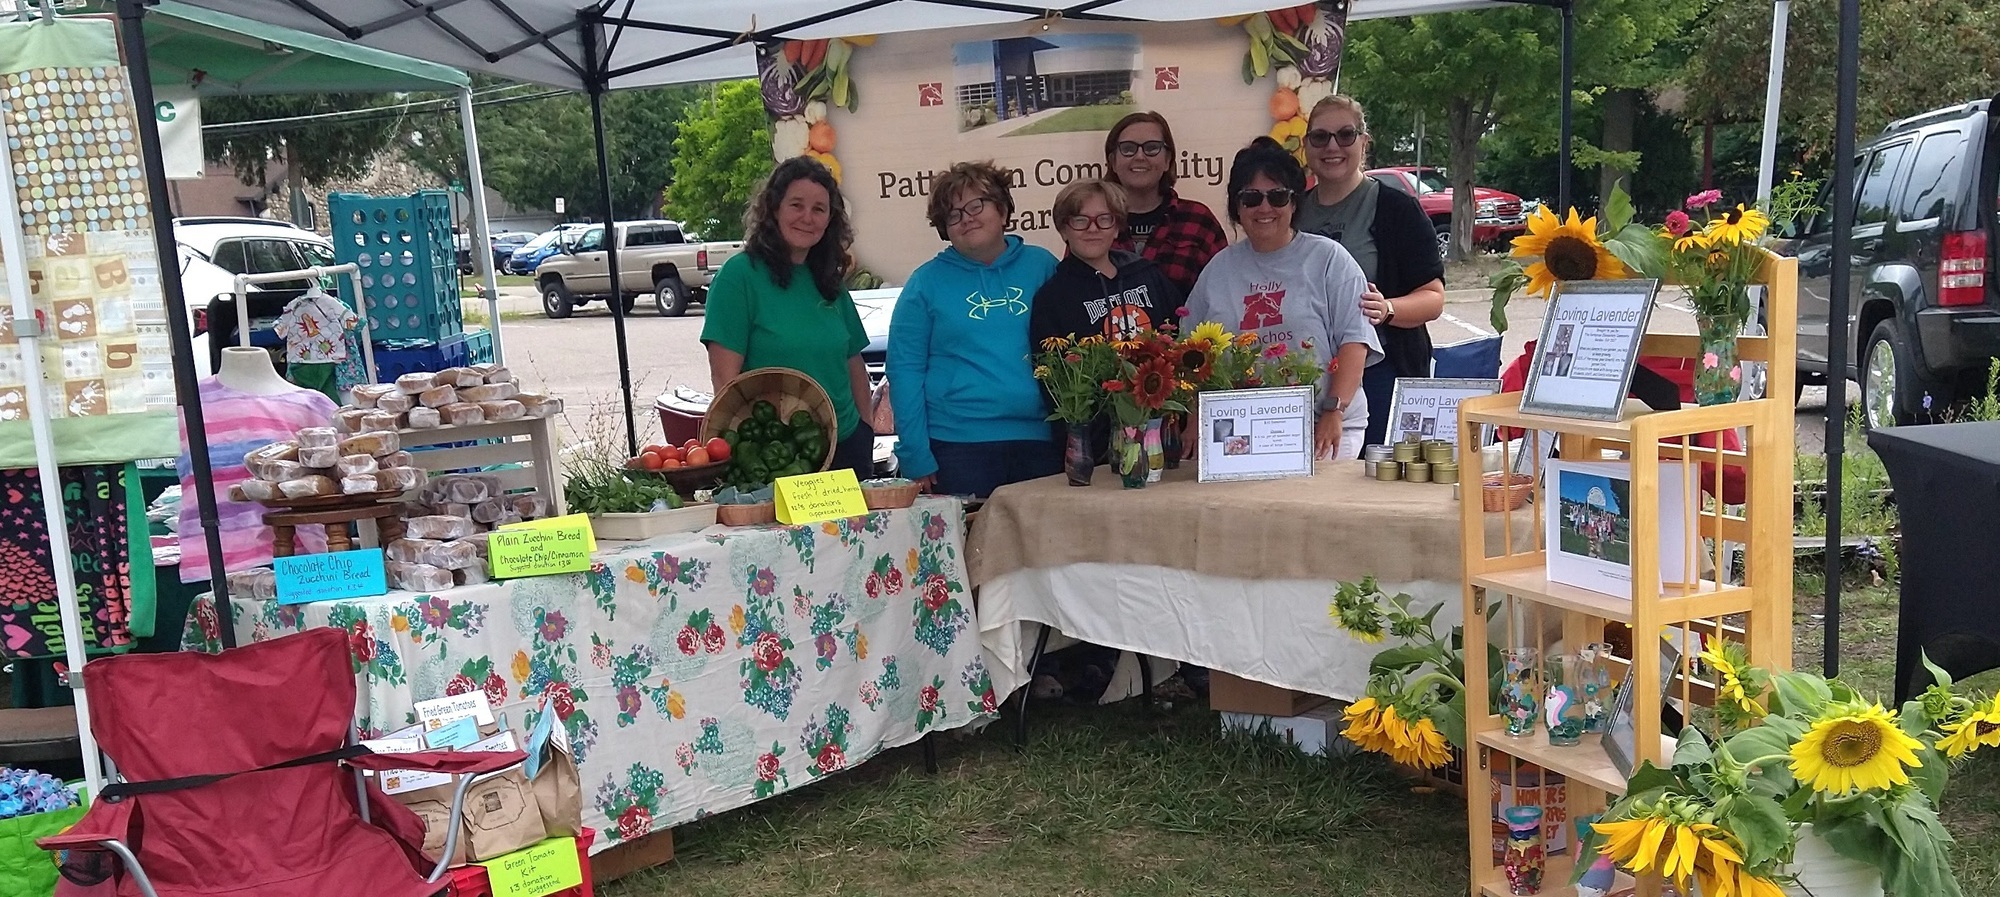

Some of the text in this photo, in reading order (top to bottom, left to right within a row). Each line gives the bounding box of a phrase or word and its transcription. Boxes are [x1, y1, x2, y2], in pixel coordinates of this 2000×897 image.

[878, 150, 1223, 199] Pattn Comity
[1249, 281, 1283, 292] Holly
[1554, 306, 1640, 325] Loving Lavender
[1401, 395, 1436, 408] Loving
[1209, 404, 1303, 418] Loving Lavender
[793, 477, 824, 491] Veggies
[808, 499, 842, 510] donations
[497, 529, 581, 547] Plain Zucchini Bread
[530, 542, 544, 552] and
[281, 555, 353, 576] Chocolate Chip
[500, 552, 533, 565] Chocolate
[299, 566, 371, 585] Zucchini Bread
[422, 707, 438, 718] Fried
[437, 704, 452, 716] Green
[451, 700, 477, 713] Tomatoes
[504, 849, 556, 871] Green Tomato
[520, 865, 536, 878] Kit
[522, 873, 553, 888] donation
